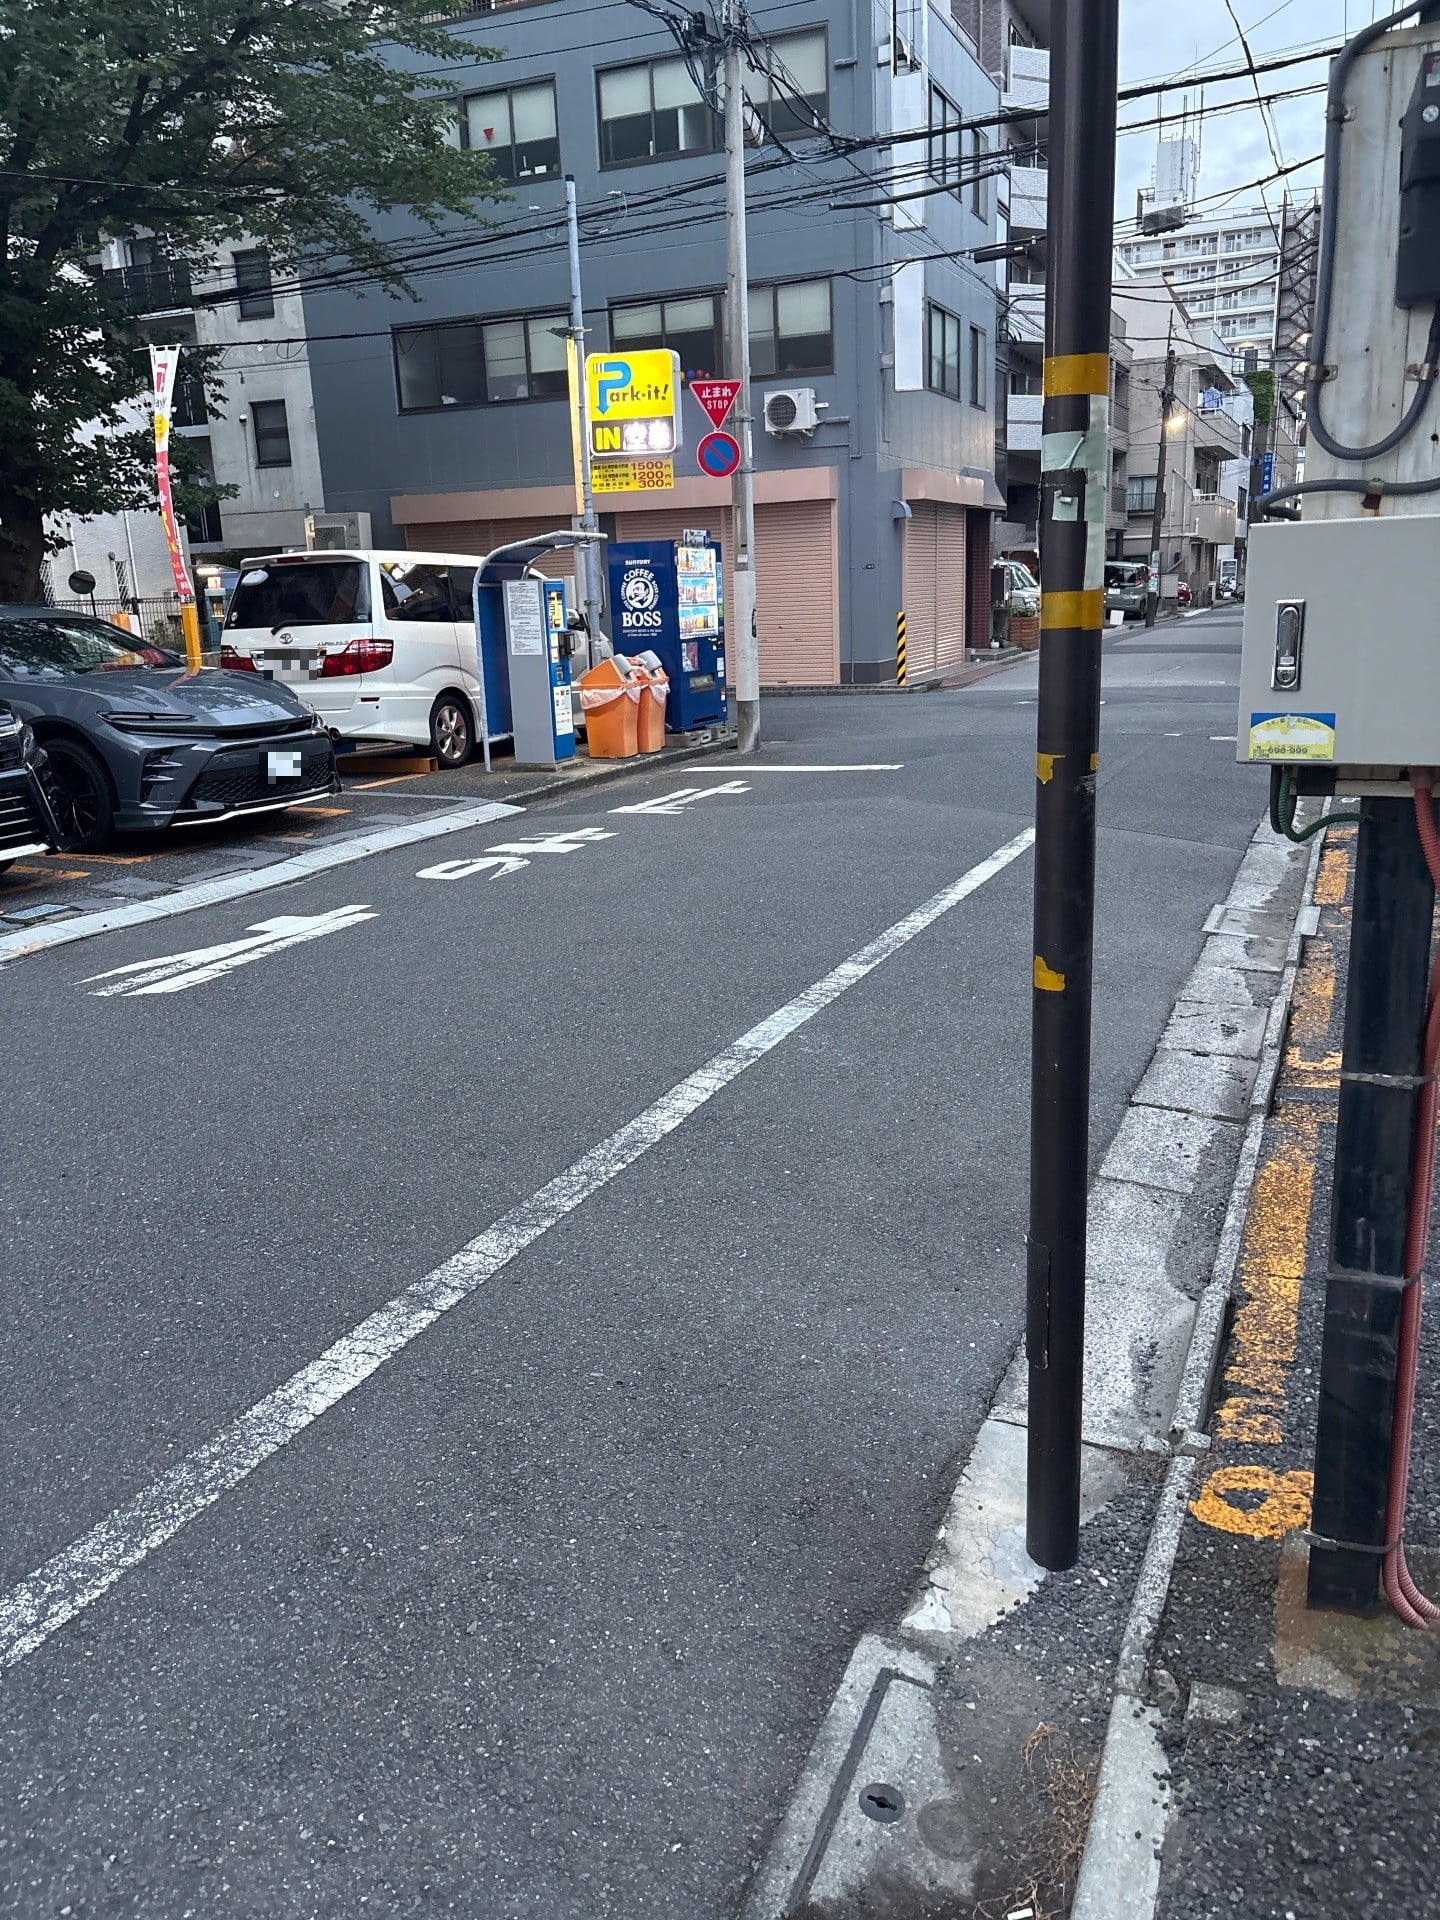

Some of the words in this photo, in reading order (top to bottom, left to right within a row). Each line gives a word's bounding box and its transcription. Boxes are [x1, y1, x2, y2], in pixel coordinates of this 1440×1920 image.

[701, 385, 733, 399] 止まれ
[706, 399, 729, 410] STOP
[595, 426, 621, 450] IN
[623, 568, 655, 582] COFFEE
[621, 611, 662, 627] BOSS
